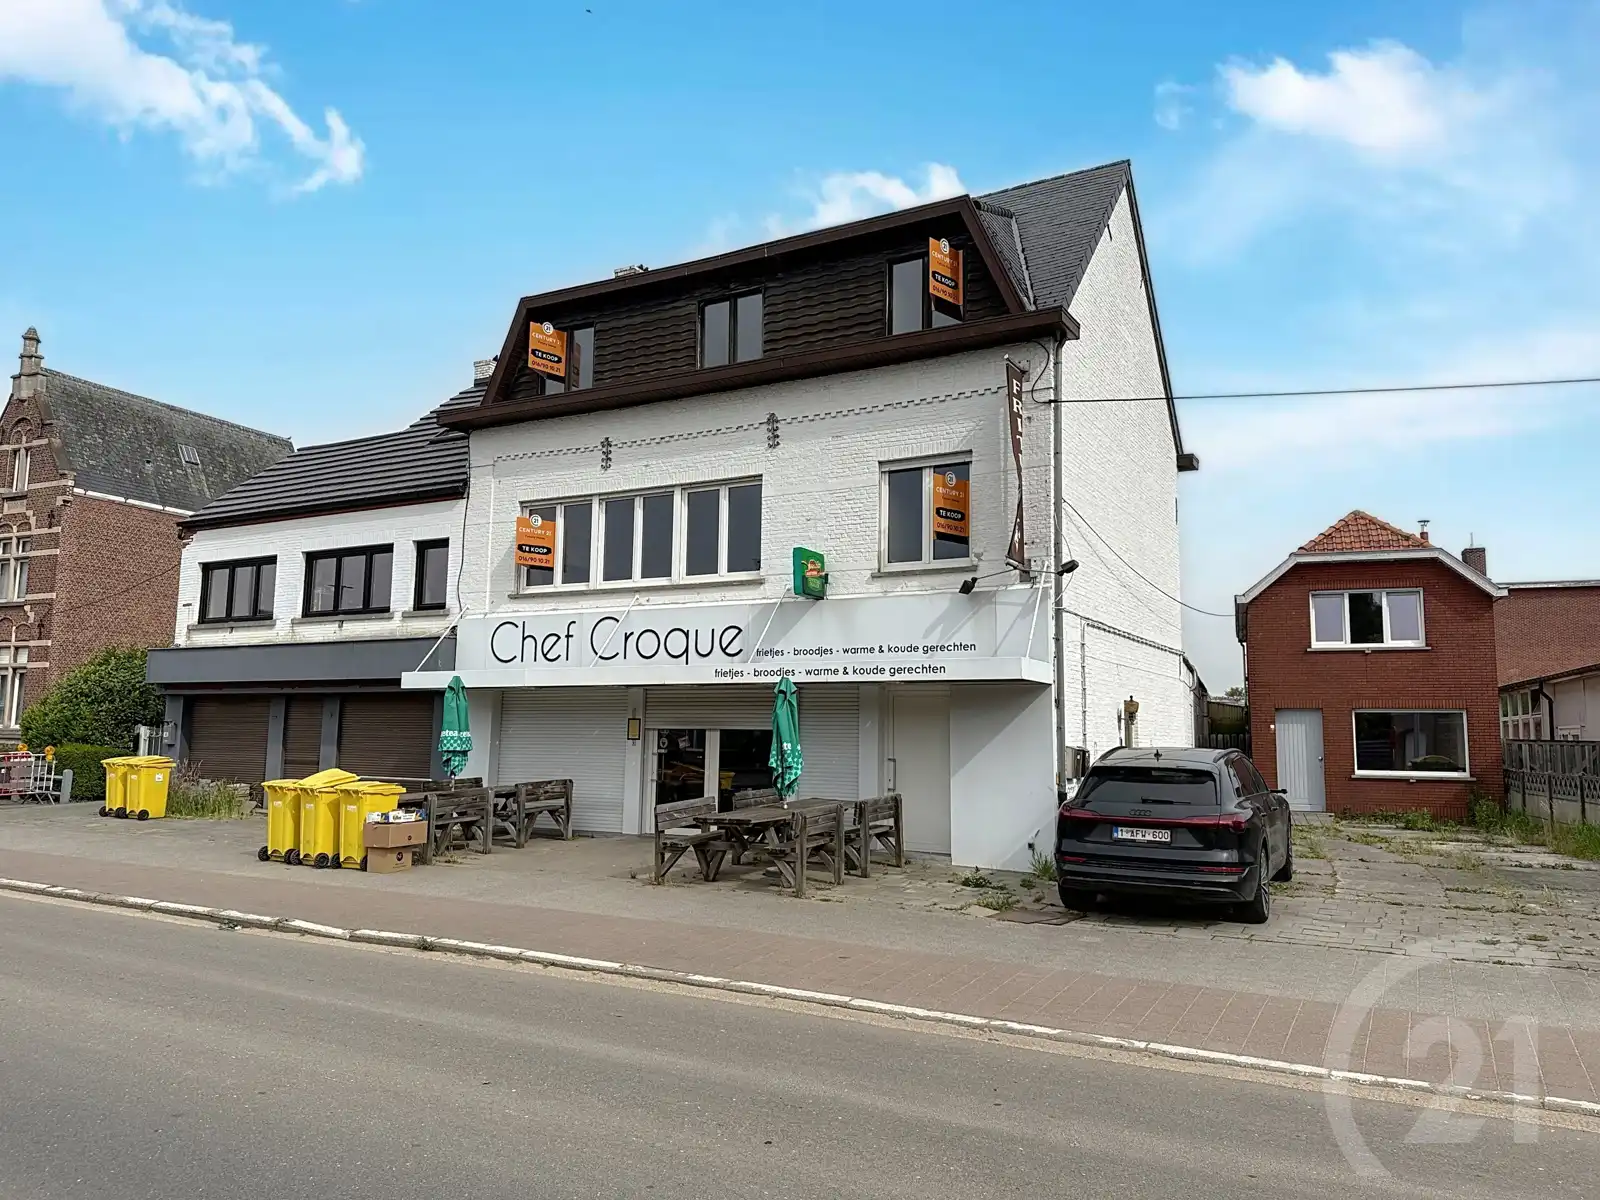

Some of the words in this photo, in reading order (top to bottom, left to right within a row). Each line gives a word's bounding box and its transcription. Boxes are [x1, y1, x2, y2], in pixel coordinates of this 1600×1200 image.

[932, 250, 952, 264] CENTURY
[942, 277, 955, 287] KOOP
[532, 332, 556, 343] CENTURY
[936, 487, 959, 496] CENTURY
[490, 620, 576, 664] Chef
[590, 616, 744, 665] Croque
[756, 648, 784, 658] frietjes
[793, 646, 833, 657] broodjes
[878, 645, 884, 654] &
[888, 644, 919, 653] koude
[922, 642, 976, 654] gerechten
[714, 668, 744, 679] frietjes
[754, 667, 796, 678] broodjes
[805, 668, 839, 676] warme
[842, 667, 849, 675] &
[852, 665, 886, 675] koude
[888, 664, 946, 676] gerechten
